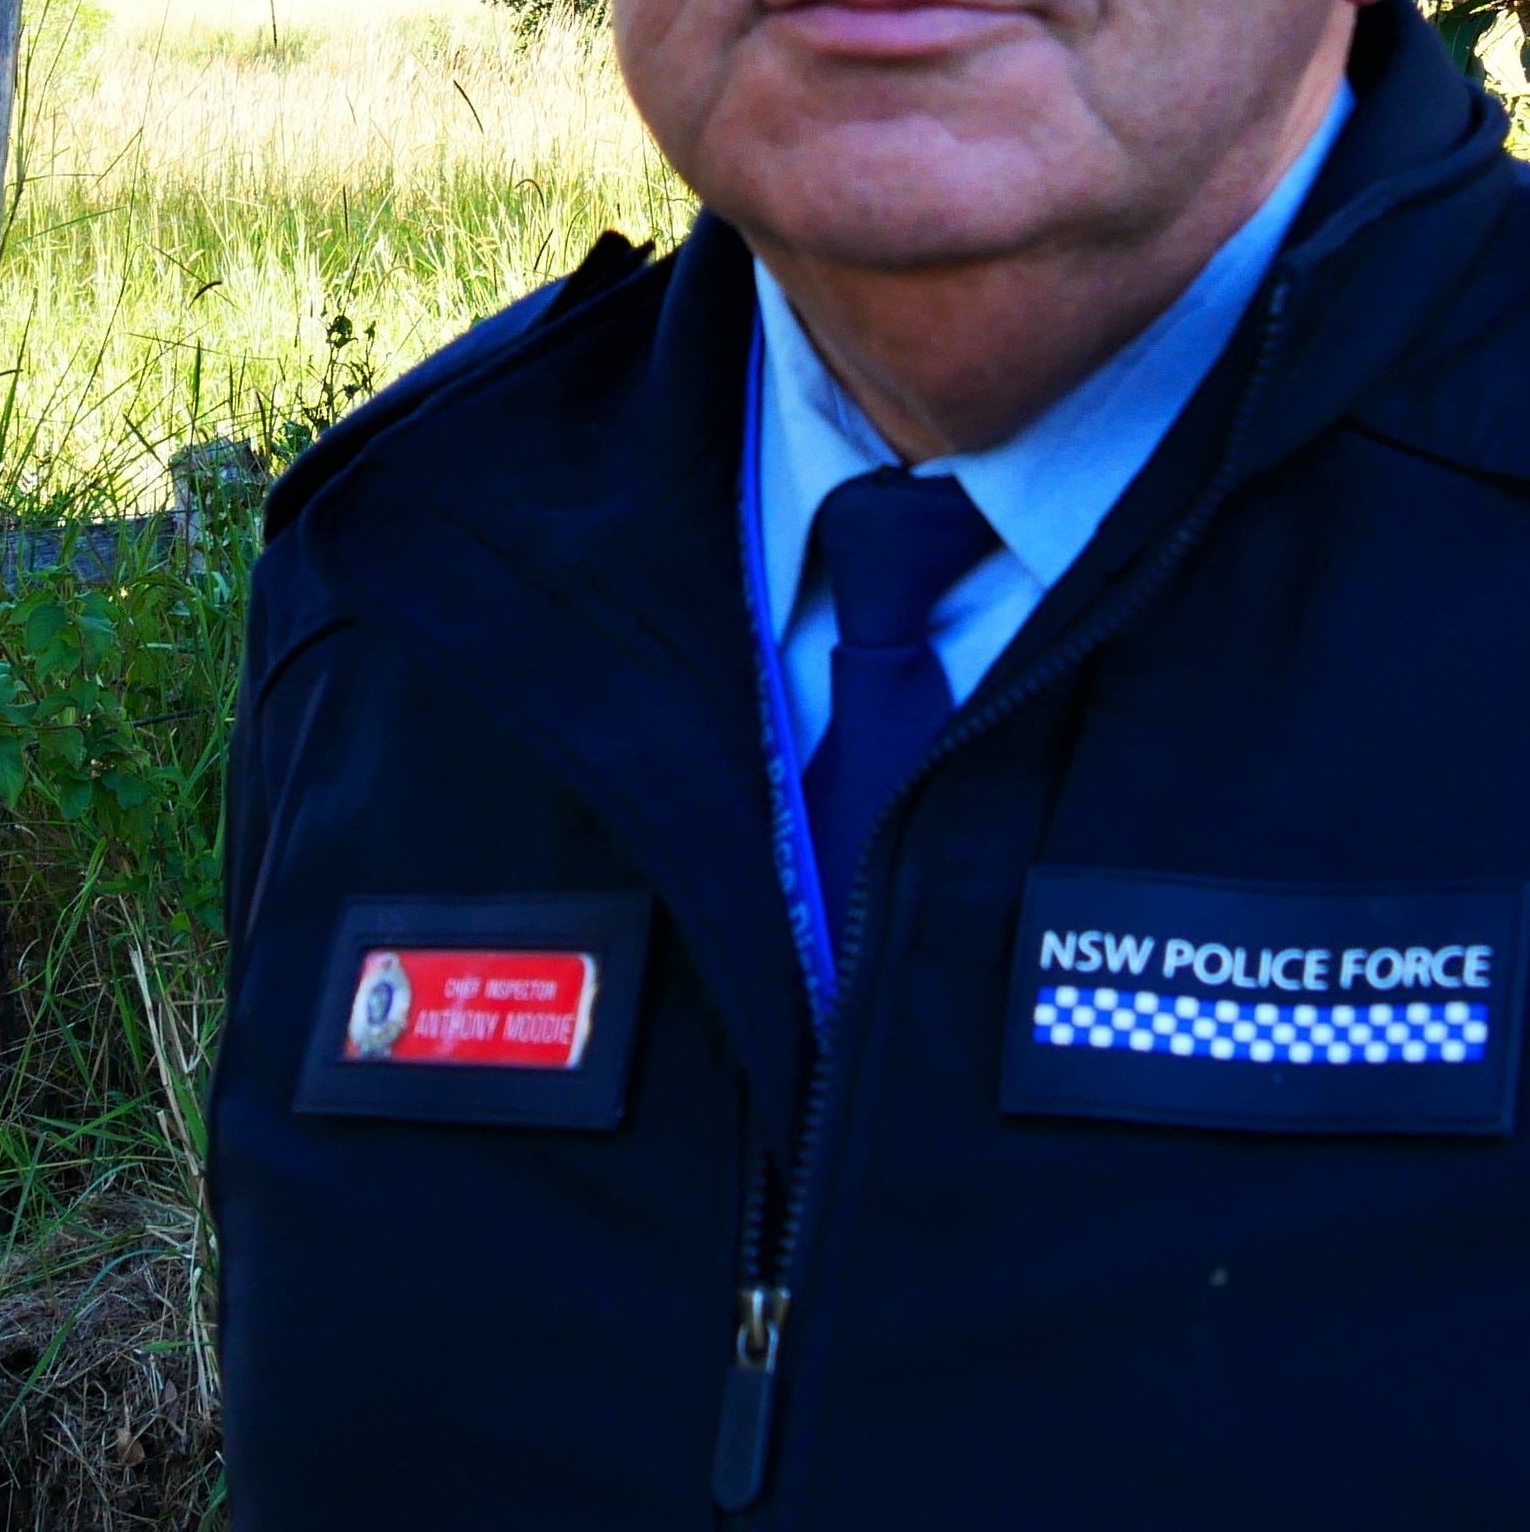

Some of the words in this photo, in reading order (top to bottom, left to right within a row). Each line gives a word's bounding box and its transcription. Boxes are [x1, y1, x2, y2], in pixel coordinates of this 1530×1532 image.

[1040, 930, 1156, 976] NSW
[1162, 938, 1331, 991] POLICE
[1339, 944, 1493, 990] FORCE
[444, 976, 482, 1000] CHIEF
[484, 978, 559, 1002] INSPECTOR
[413, 1008, 501, 1042] ANTHONY
